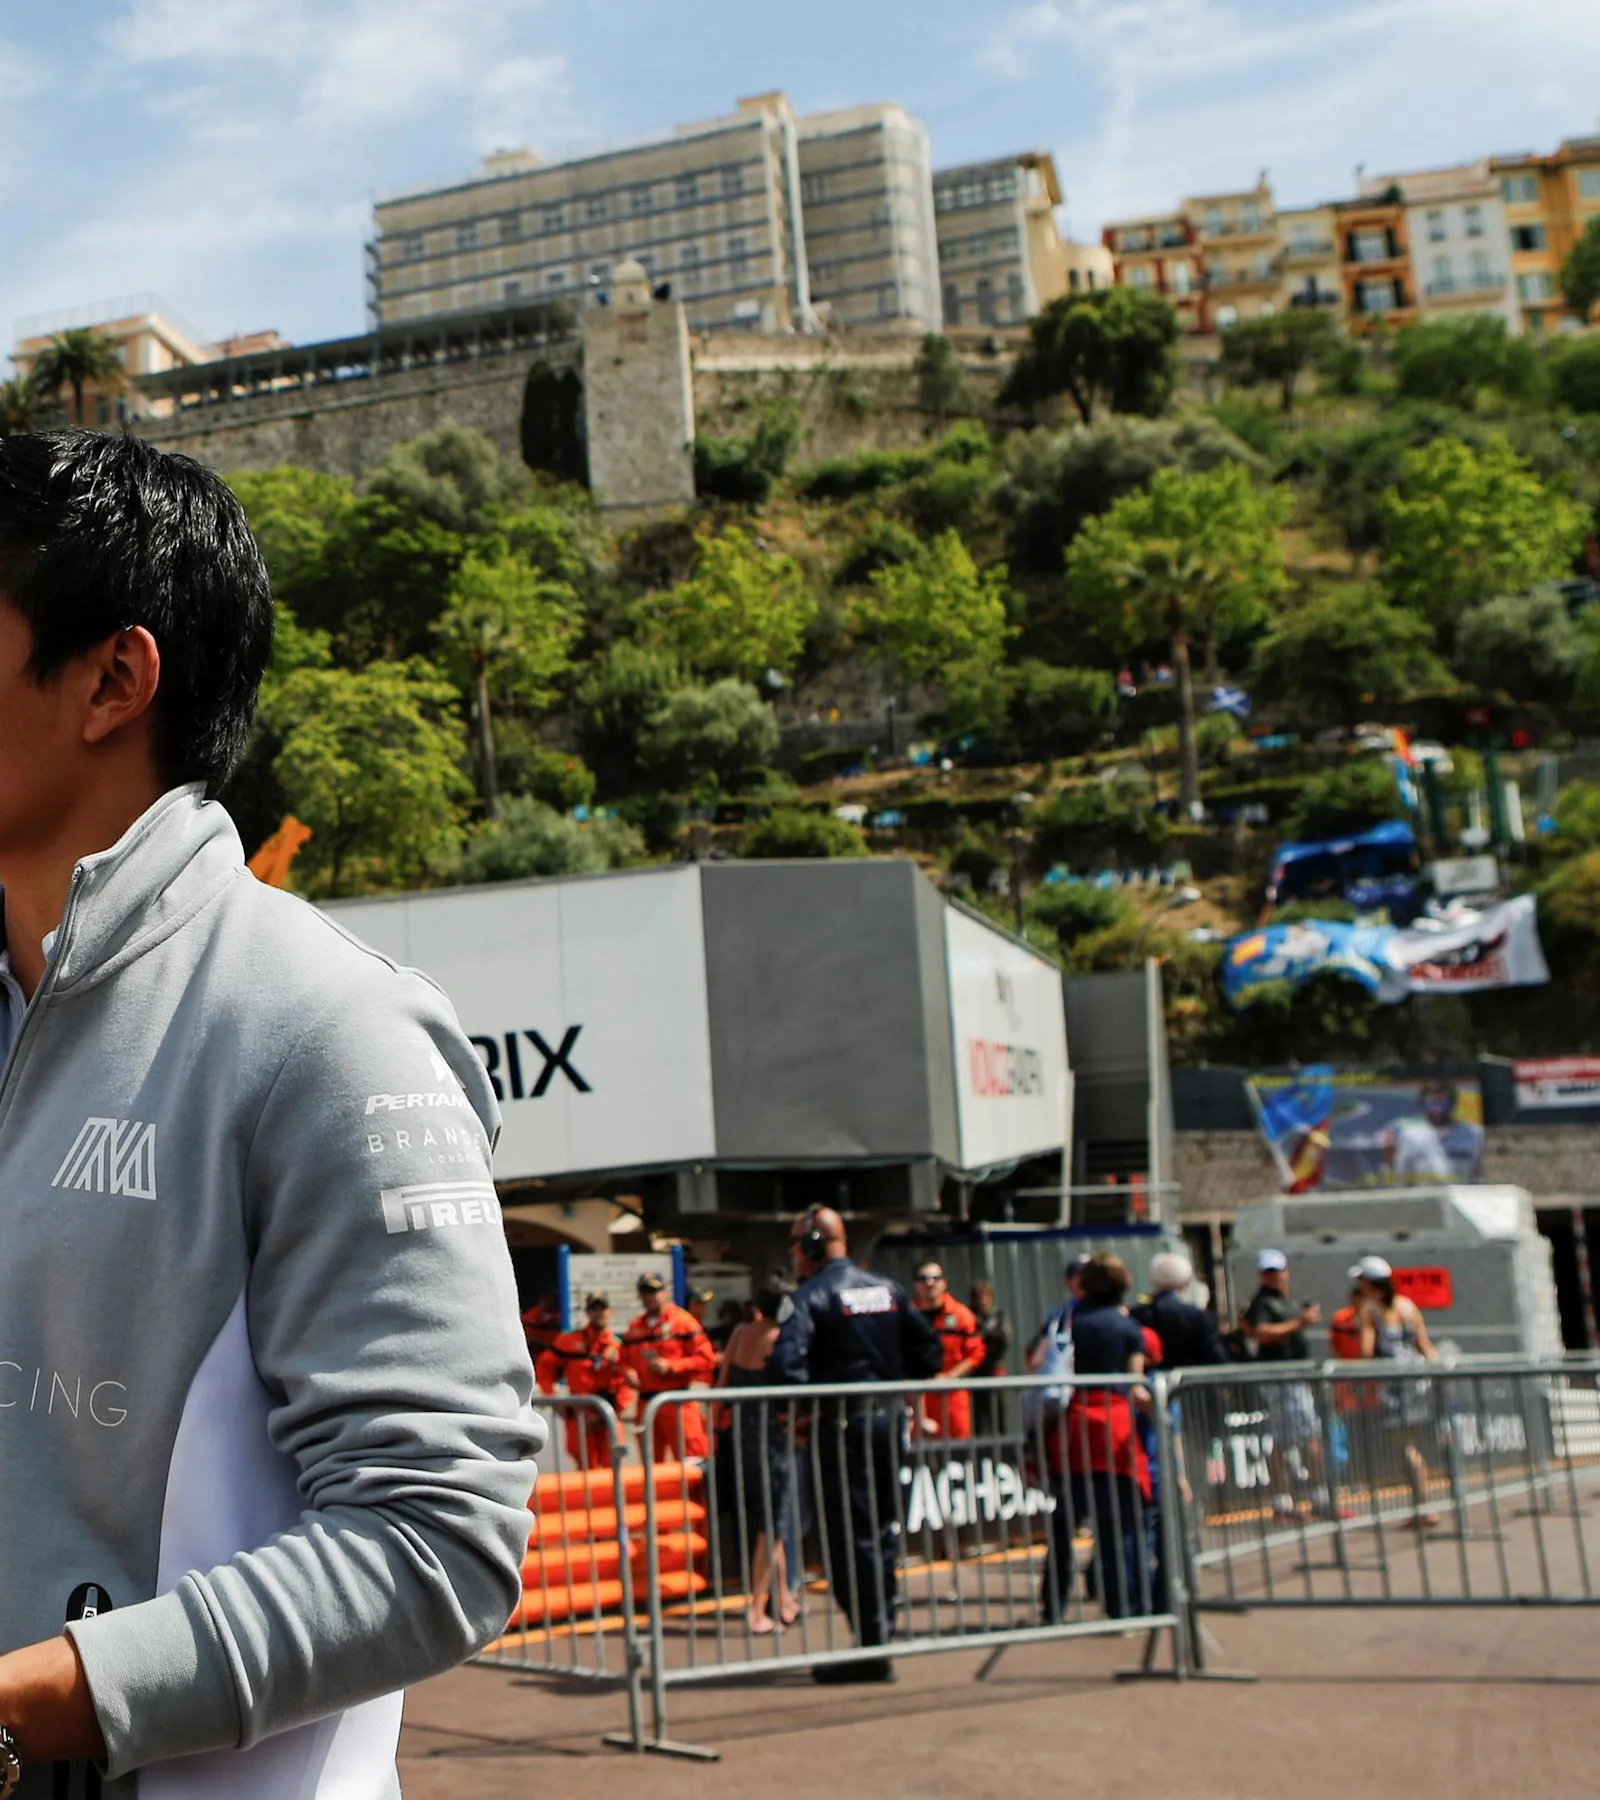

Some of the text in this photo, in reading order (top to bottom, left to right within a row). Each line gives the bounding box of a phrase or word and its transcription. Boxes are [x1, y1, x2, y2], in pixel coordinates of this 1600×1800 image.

[468, 1024, 593, 1101] RIX
[365, 1092, 473, 1116] PERTAM
[367, 1127, 483, 1154] BRANDE
